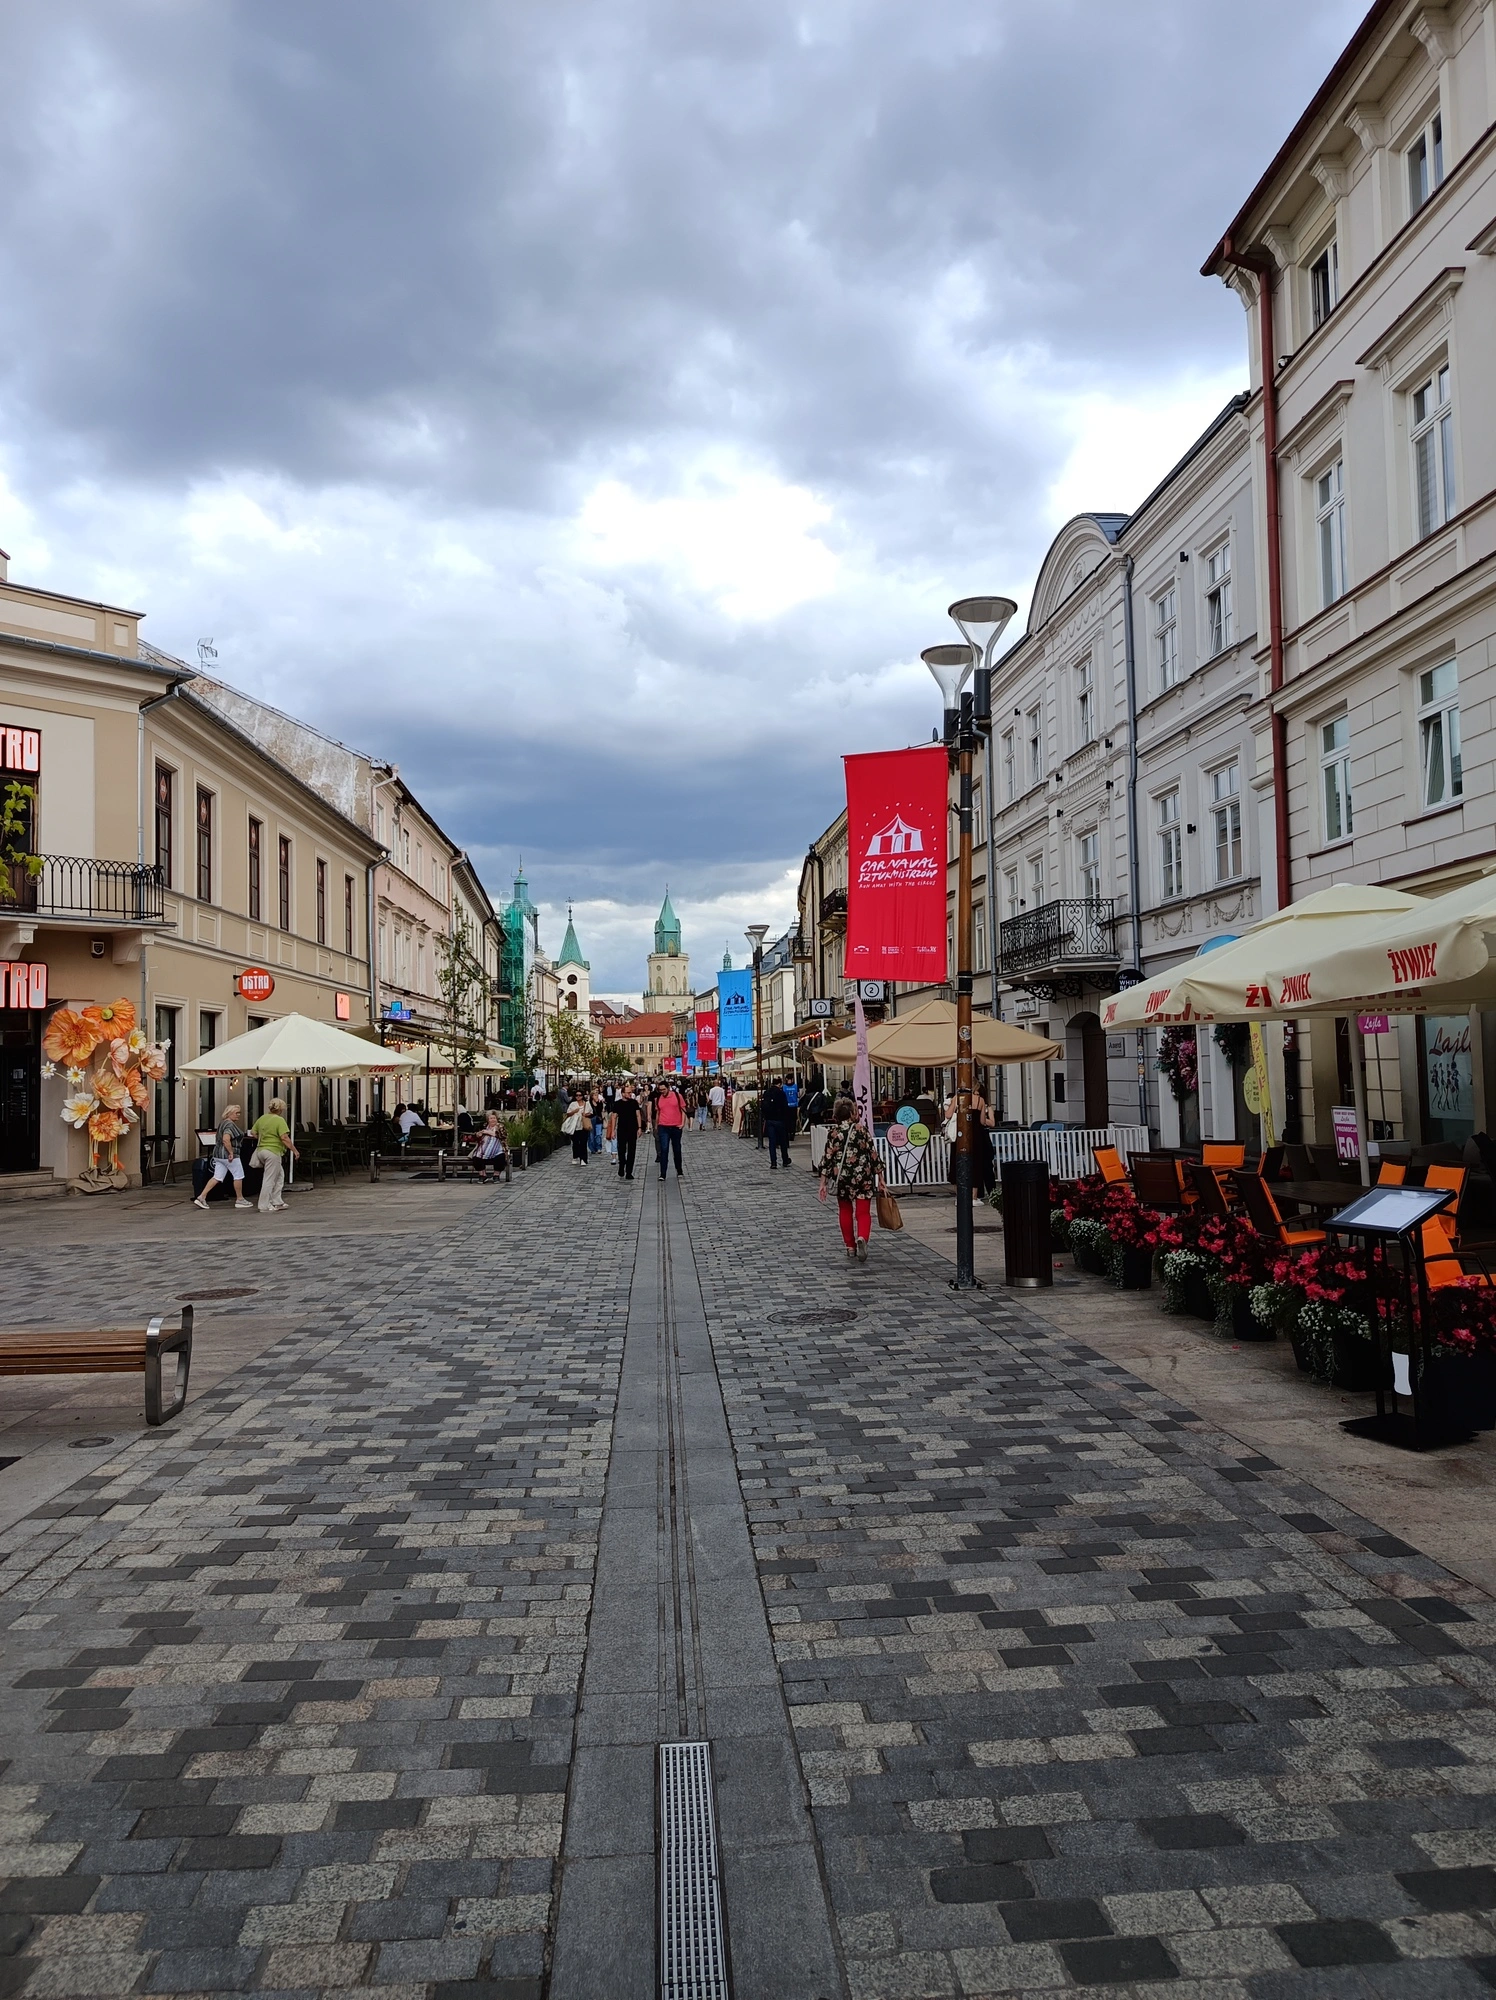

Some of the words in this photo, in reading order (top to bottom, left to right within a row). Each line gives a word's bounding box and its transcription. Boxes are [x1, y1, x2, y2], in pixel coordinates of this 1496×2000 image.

[860, 857, 938, 872] CARNAVAL
[1387, 942, 1438, 984] ŻYWIEC
[242, 975, 269, 990] OSTRO
[869, 986, 874, 994] 2
[1279, 972, 1312, 1004] ŻYWIEC
[1364, 1016, 1382, 1031] Lajla
[300, 1066, 327, 1075] OSTRO
